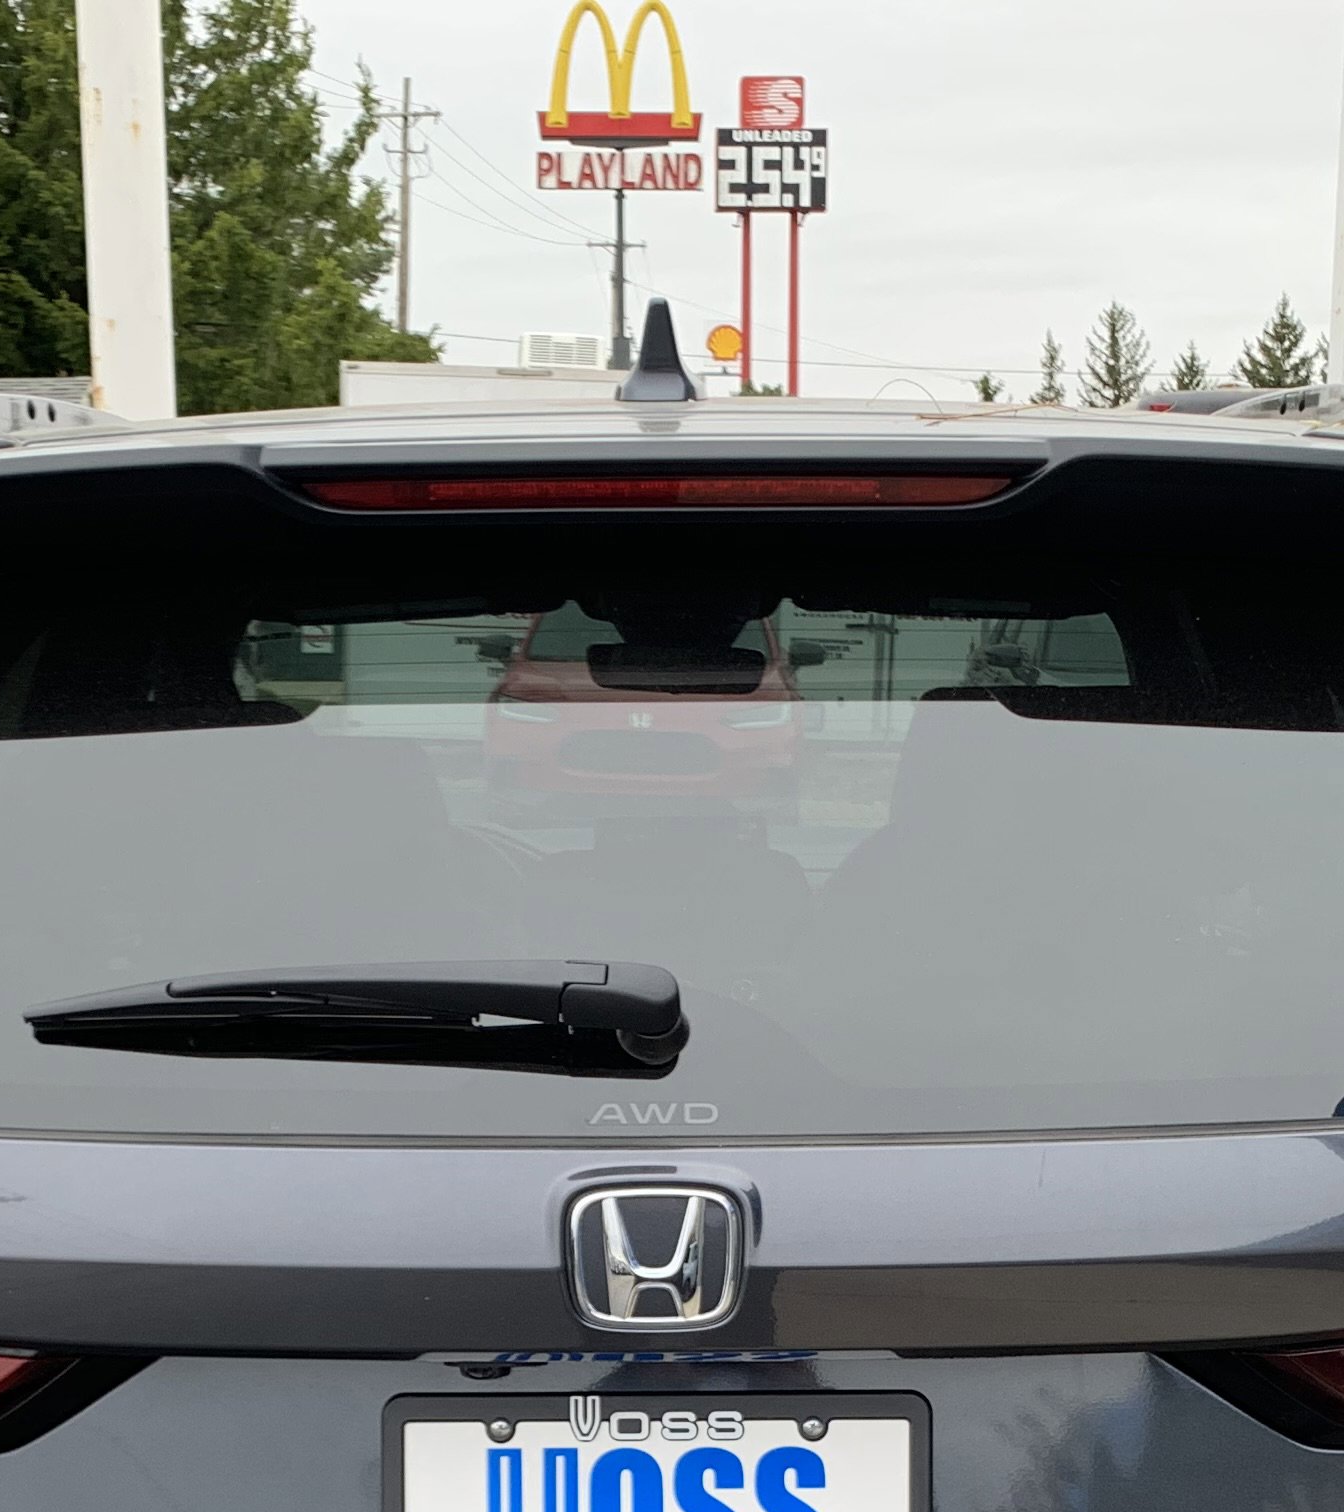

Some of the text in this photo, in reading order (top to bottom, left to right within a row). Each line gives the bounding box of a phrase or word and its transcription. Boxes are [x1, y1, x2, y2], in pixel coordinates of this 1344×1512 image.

[731, 130, 814, 143] UNLEADED
[537, 152, 703, 189] PLAYLAND
[587, 1103, 720, 1126] AWD
